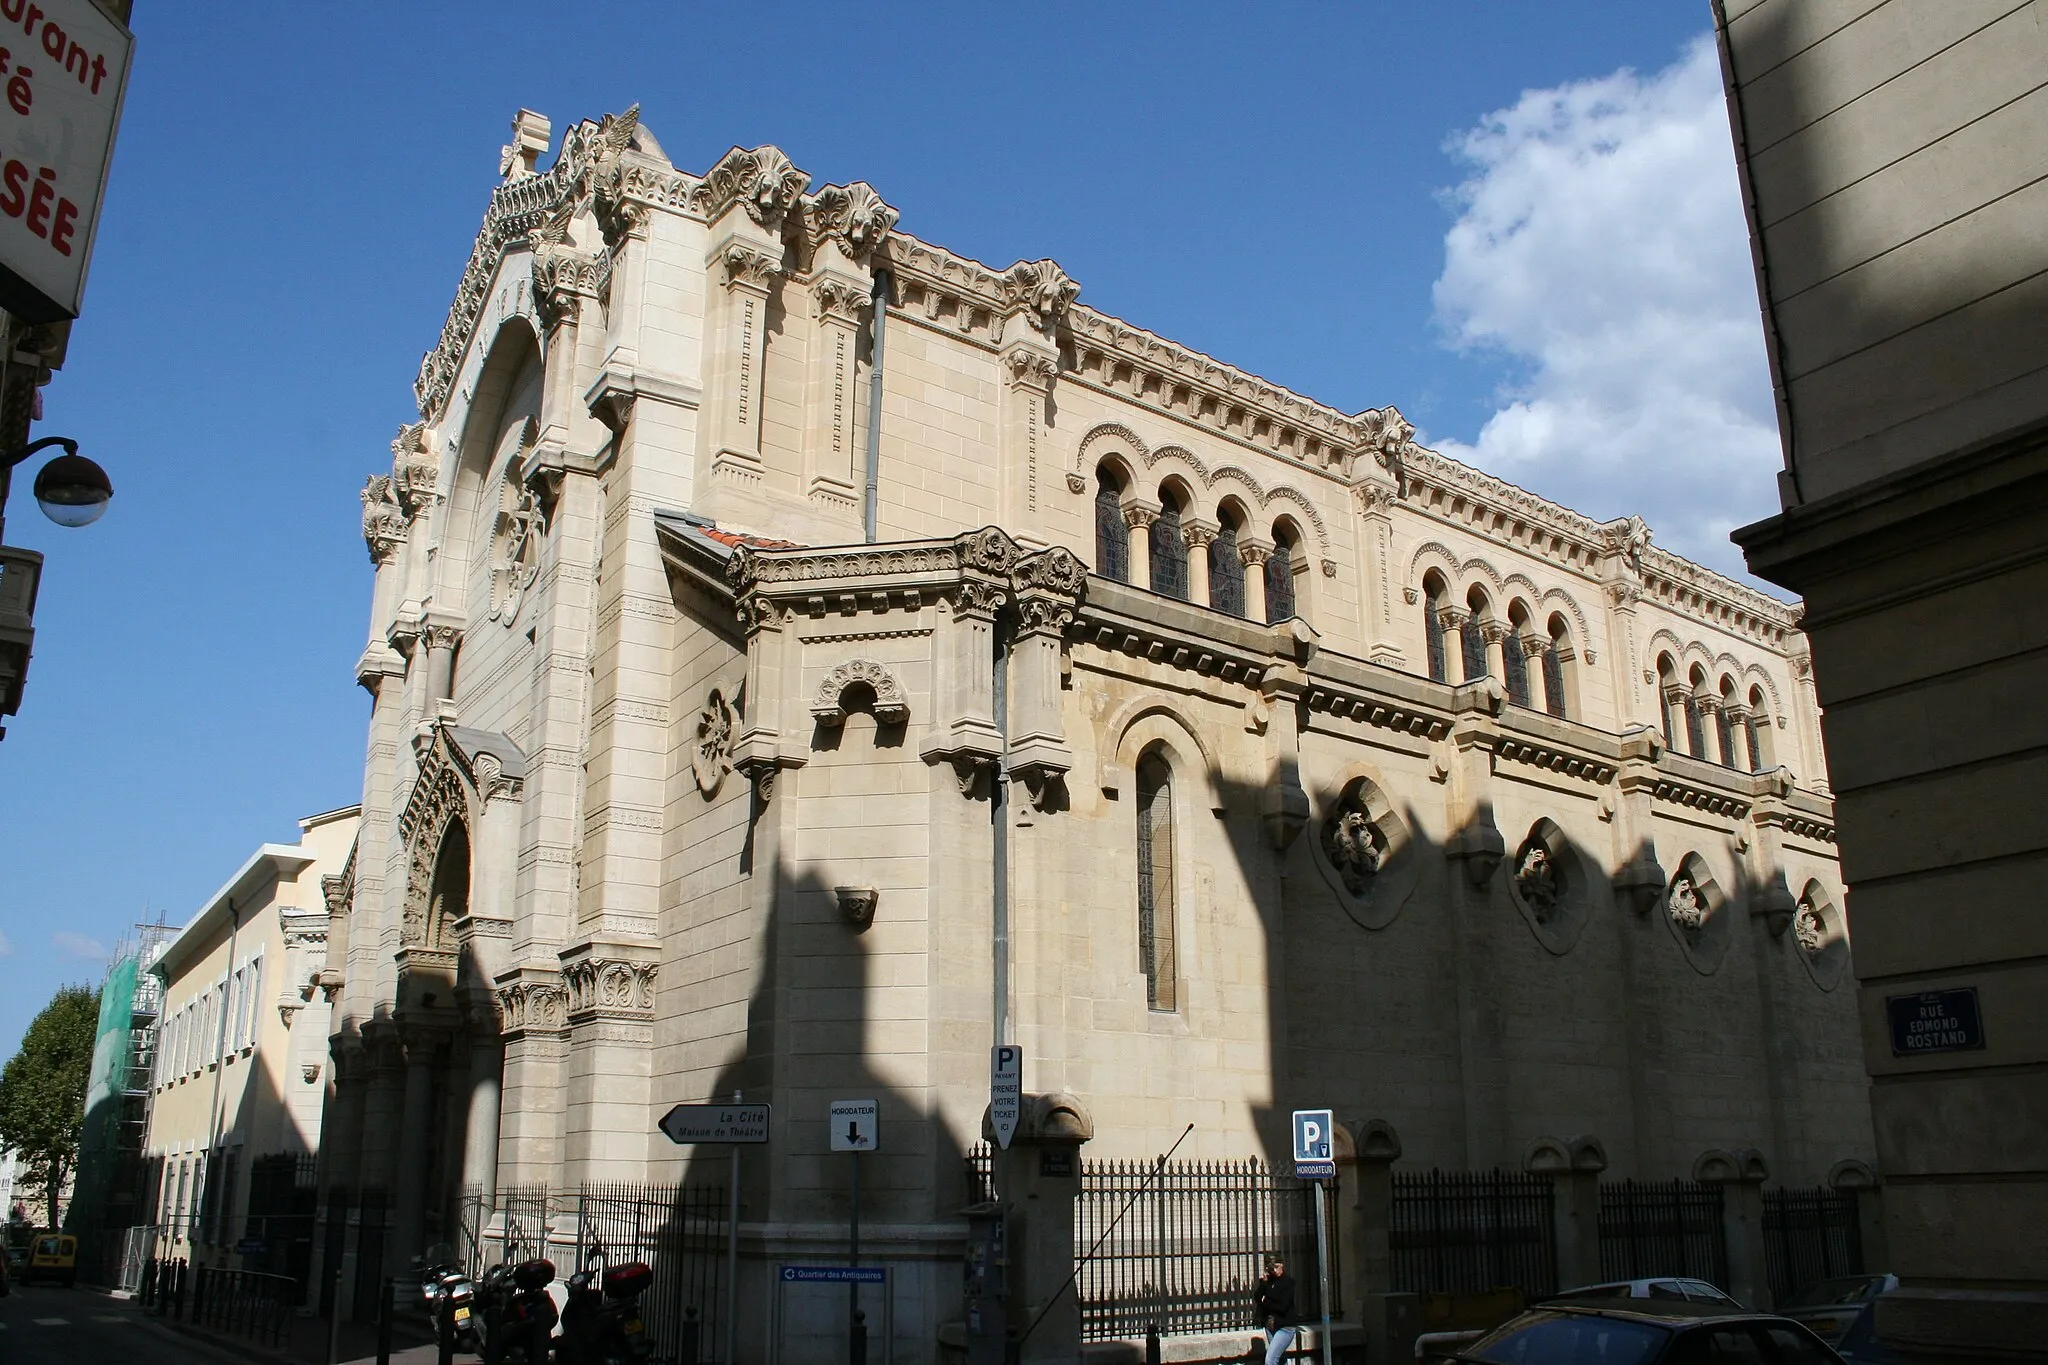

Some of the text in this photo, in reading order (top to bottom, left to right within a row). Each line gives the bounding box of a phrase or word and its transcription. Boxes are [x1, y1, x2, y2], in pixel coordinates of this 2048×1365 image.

[1920, 1004, 1945, 1019] RUE
[1910, 1017, 1959, 1033] EDMOND
[1906, 1030, 1967, 1049] ROSTAND
[998, 1048, 1014, 1071] P
[992, 1085, 1018, 1093] PRENEZ
[994, 1098, 1016, 1106] VOTRE
[831, 1106, 876, 1115] HORODATEUR
[994, 1110, 1017, 1119] TICKET
[721, 1111, 764, 1123] La Cité
[679, 1126, 764, 1137] Maison de Théâtre
[1303, 1121, 1321, 1153] P
[1296, 1164, 1333, 1175] HORODATEUR
[798, 1270, 882, 1281] Quartier des Antiquaires
